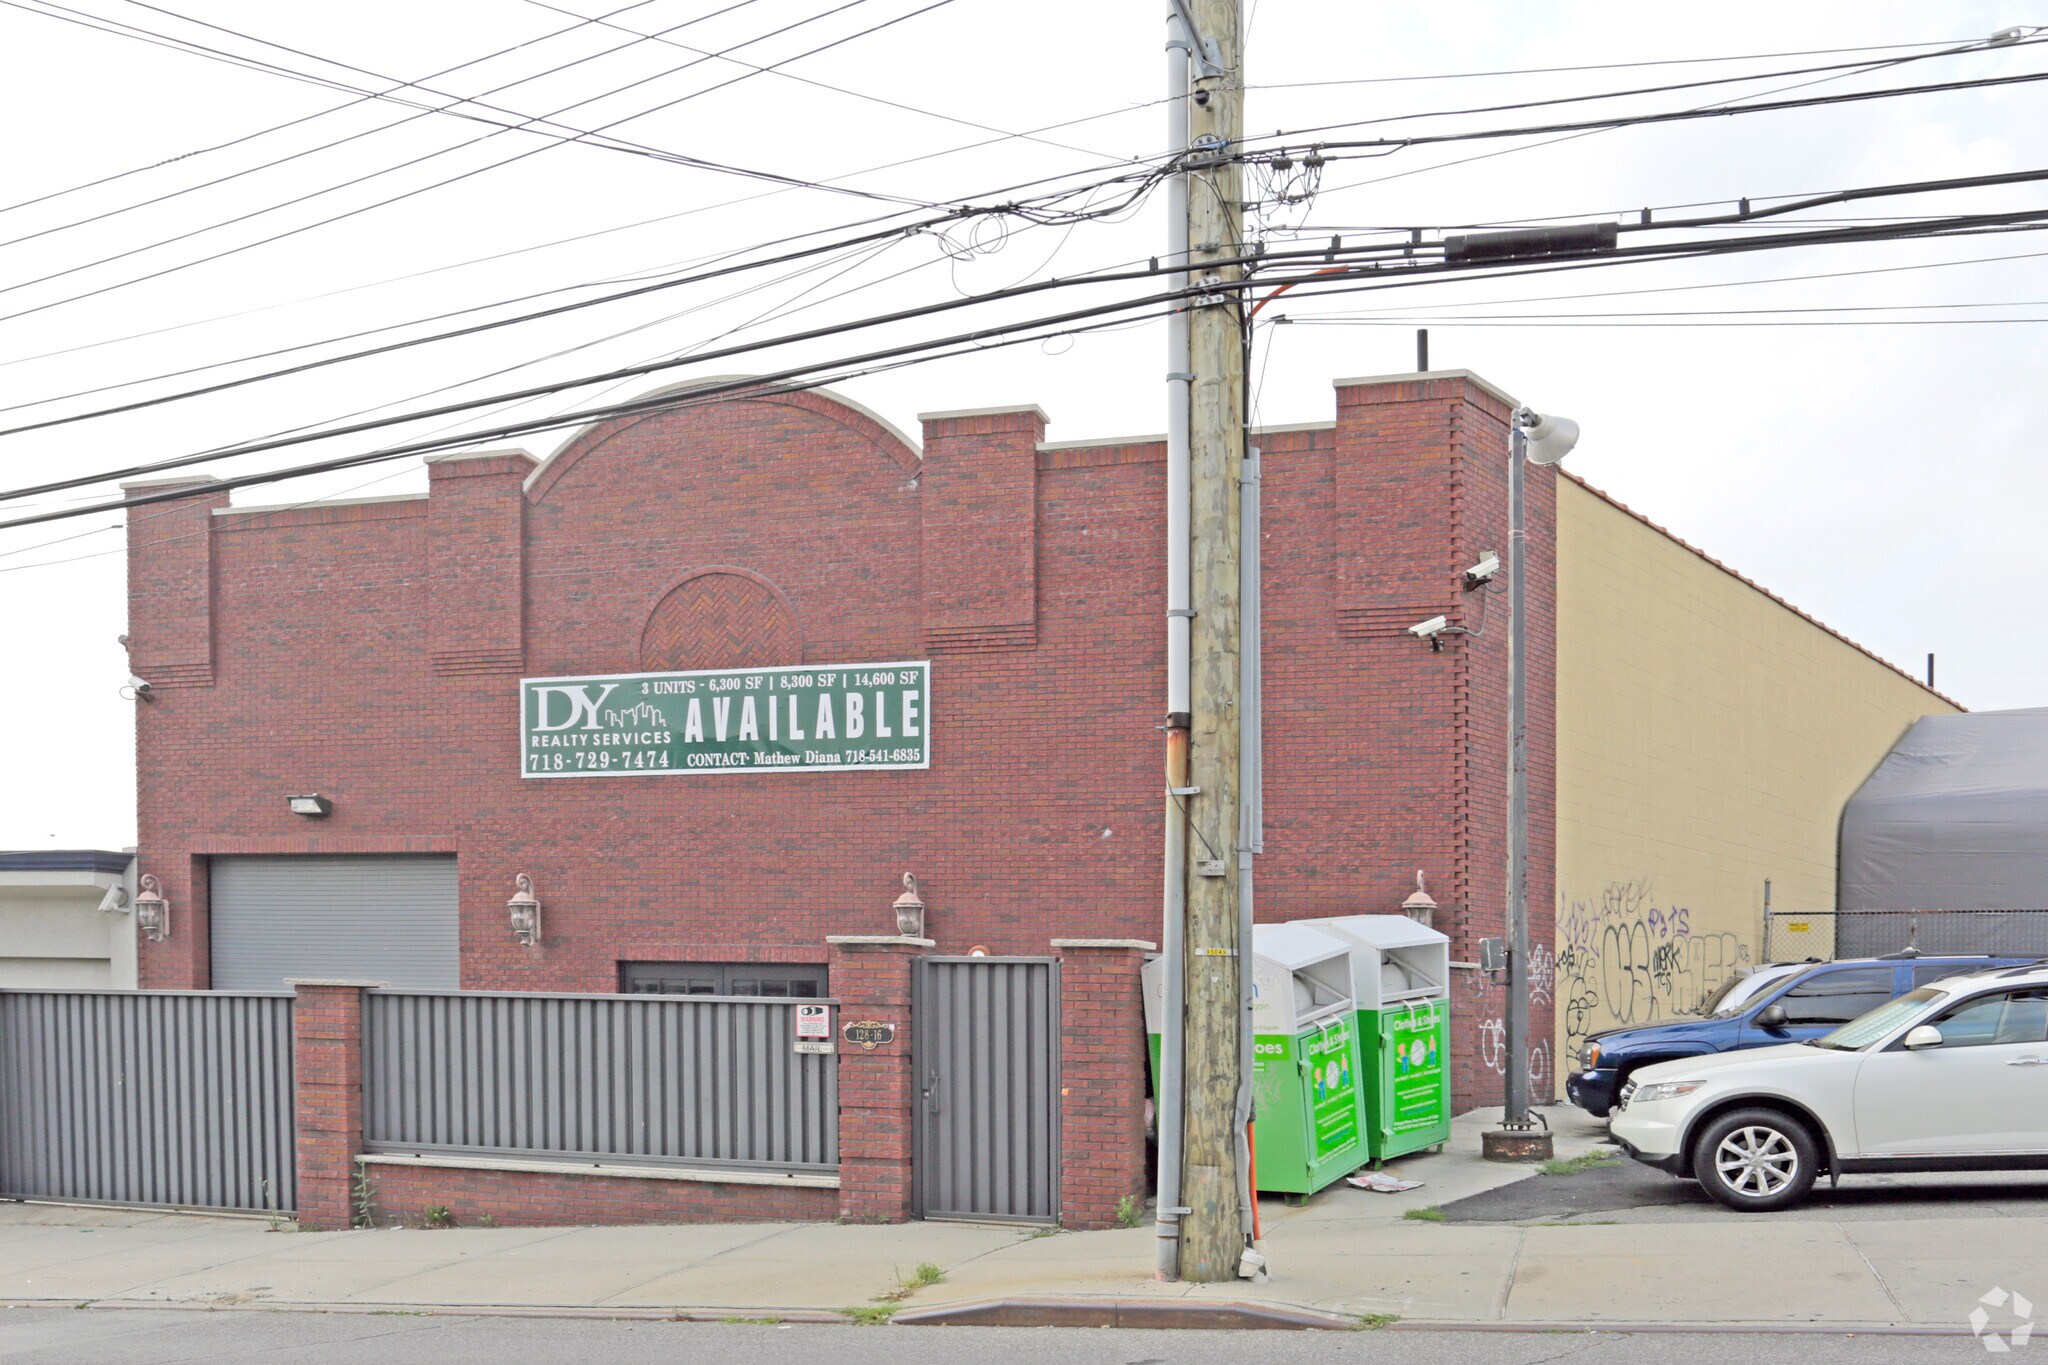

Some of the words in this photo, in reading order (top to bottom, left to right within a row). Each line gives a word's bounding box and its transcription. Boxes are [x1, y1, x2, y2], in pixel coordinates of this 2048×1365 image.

[641, 682, 649, 695] 3
[653, 680, 696, 694] UNITS
[709, 678, 740, 693] 6,300
[745, 676, 763, 690] SF
[780, 674, 813, 690] 8,300
[817, 673, 836, 687] SF
[854, 672, 895, 688] 14,600
[900, 671, 919, 685] SF
[531, 684, 620, 731] DY
[684, 690, 920, 743] AVAILABLE
[531, 734, 588, 747] REALTY
[592, 731, 671, 746] SERVICES
[529, 750, 669, 771] 718-729-7474
[753, 751, 801, 765] Mathew
[804, 750, 841, 764] Diana
[845, 748, 920, 763] 718-541-6835
[856, 1029, 882, 1041] 128-16
[802, 1044, 823, 1053] MAIL
[1254, 1043, 1283, 1054] oes
